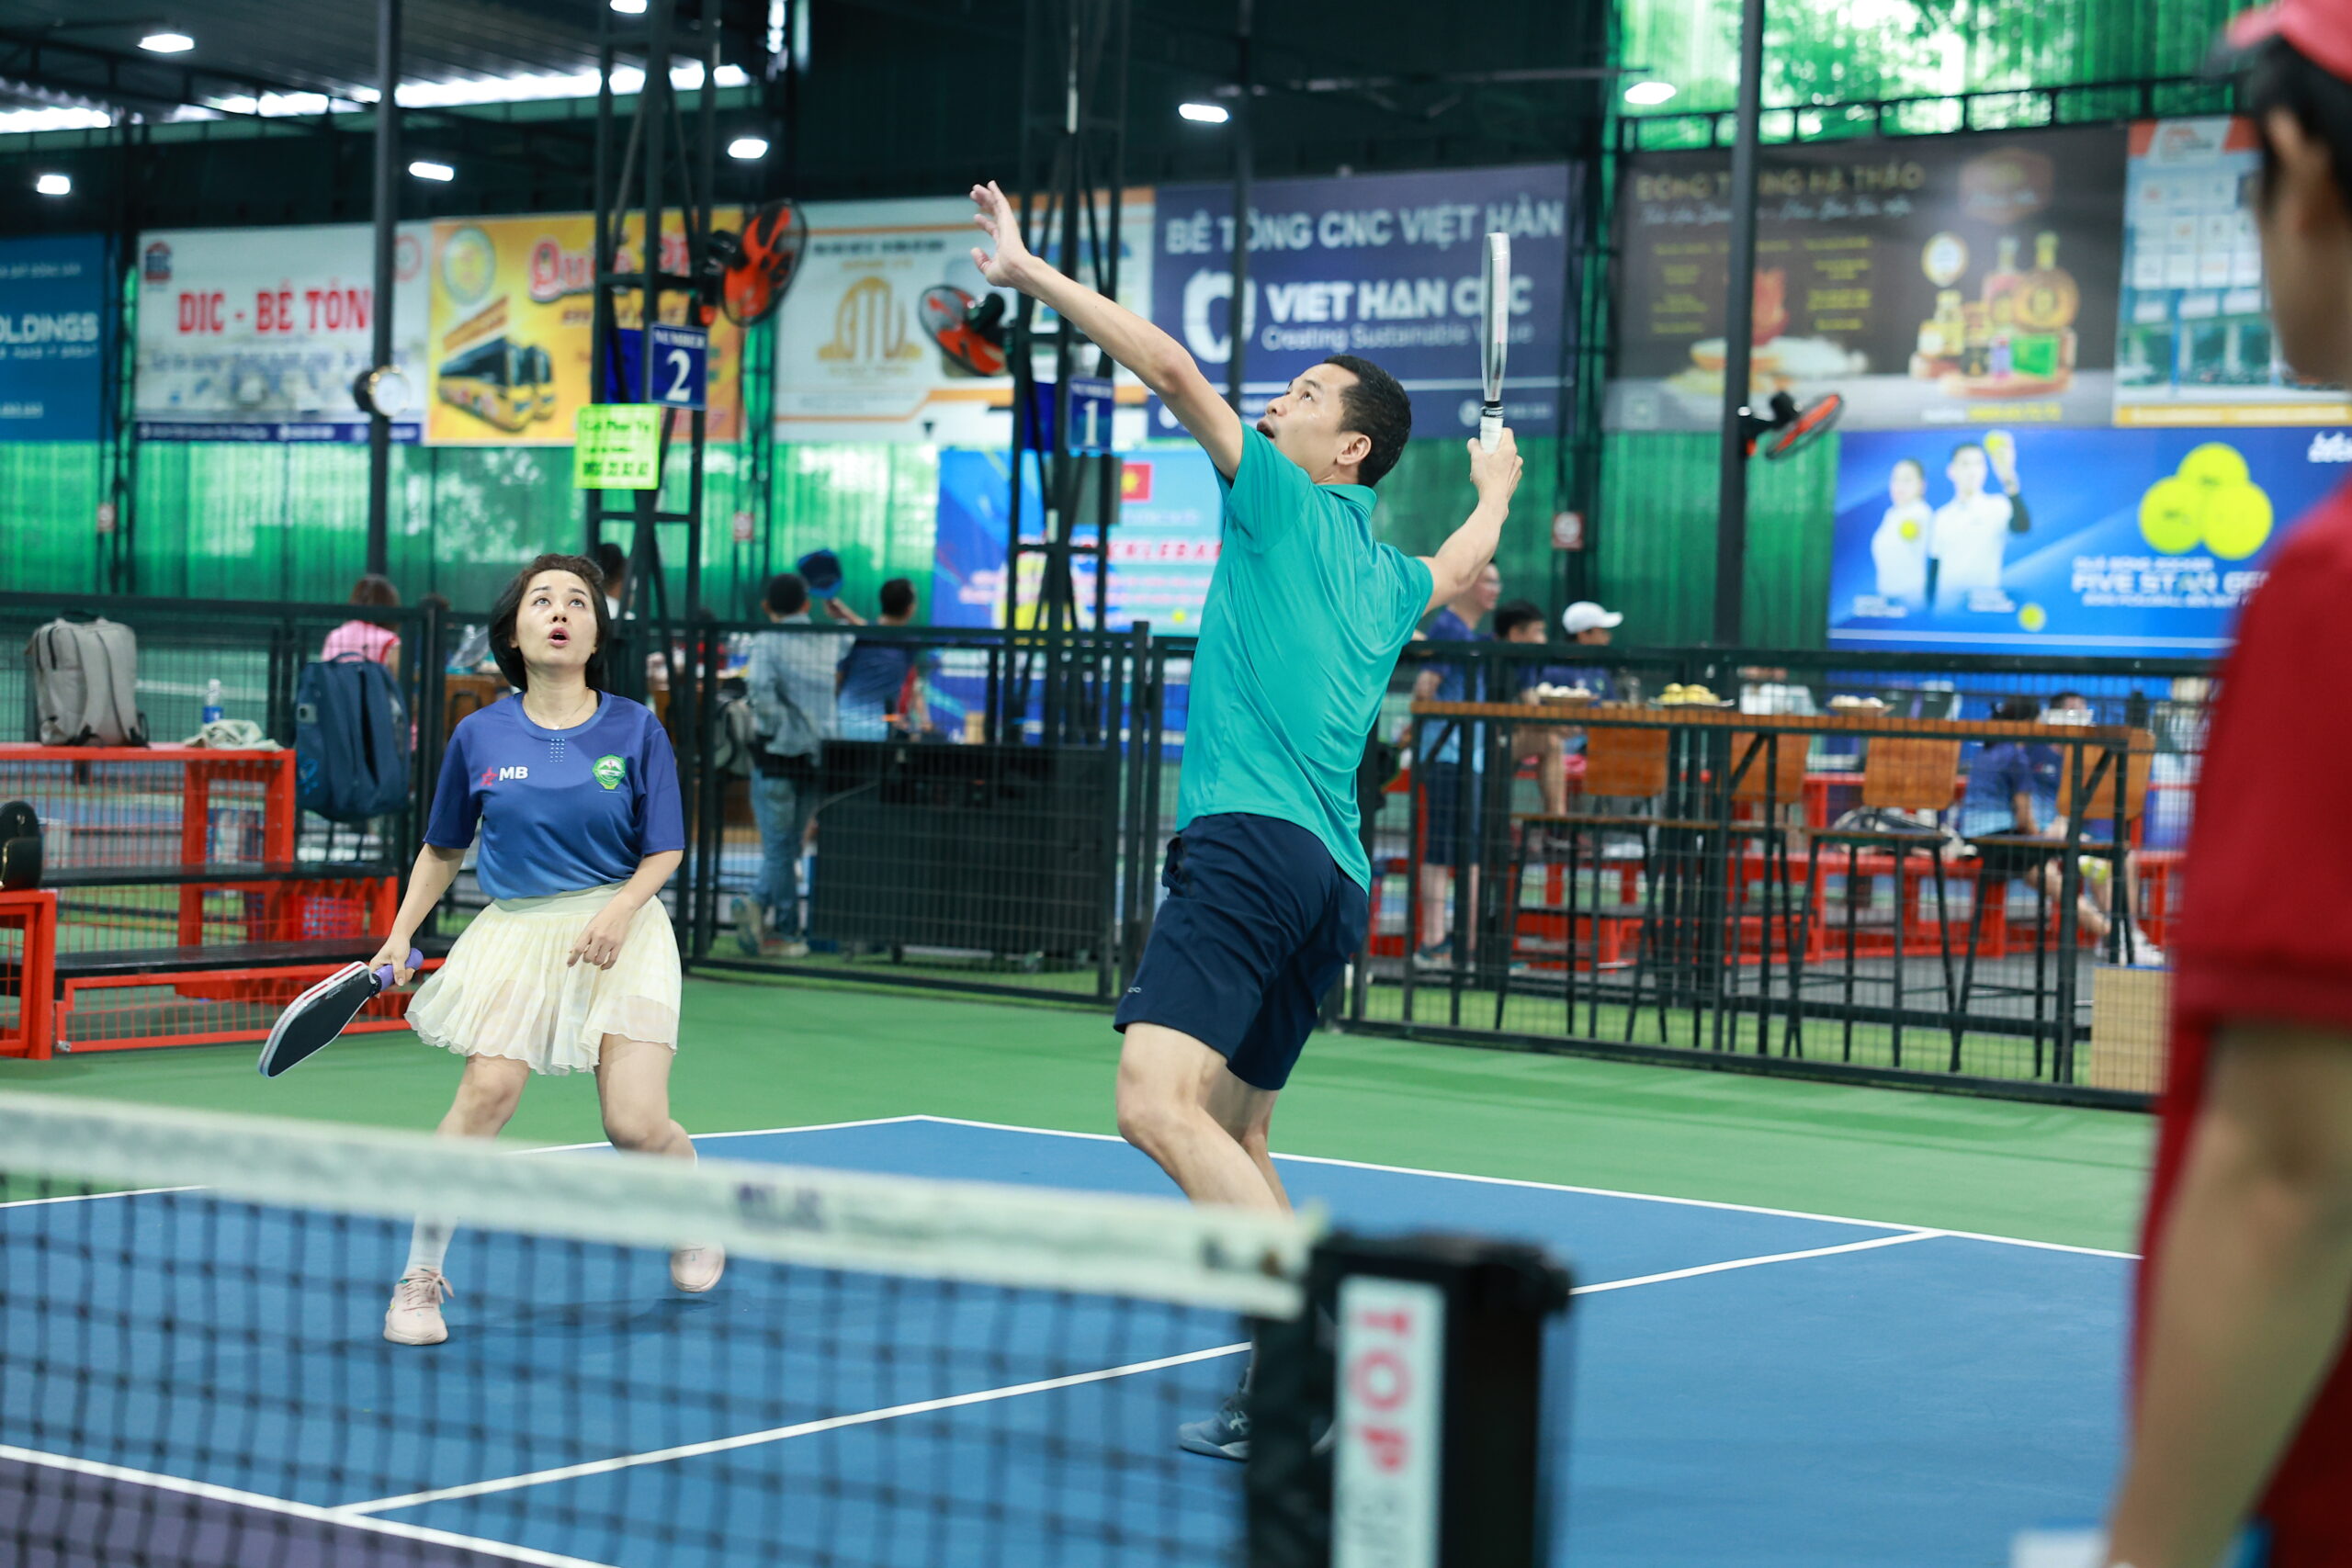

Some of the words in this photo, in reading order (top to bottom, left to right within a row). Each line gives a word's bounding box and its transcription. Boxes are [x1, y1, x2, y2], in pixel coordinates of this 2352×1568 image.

[1317, 209, 1394, 248] CNC
[177, 291, 225, 333] DIC
[304, 276, 375, 332] TÔN
[1264, 280, 1355, 323] VIET
[1357, 276, 1447, 320] HAN
[1453, 274, 1533, 318] CC
[0, 312, 99, 344] LDINGS
[665, 348, 692, 403] 2
[1083, 399, 1100, 447] 1
[499, 766, 529, 782] MB
